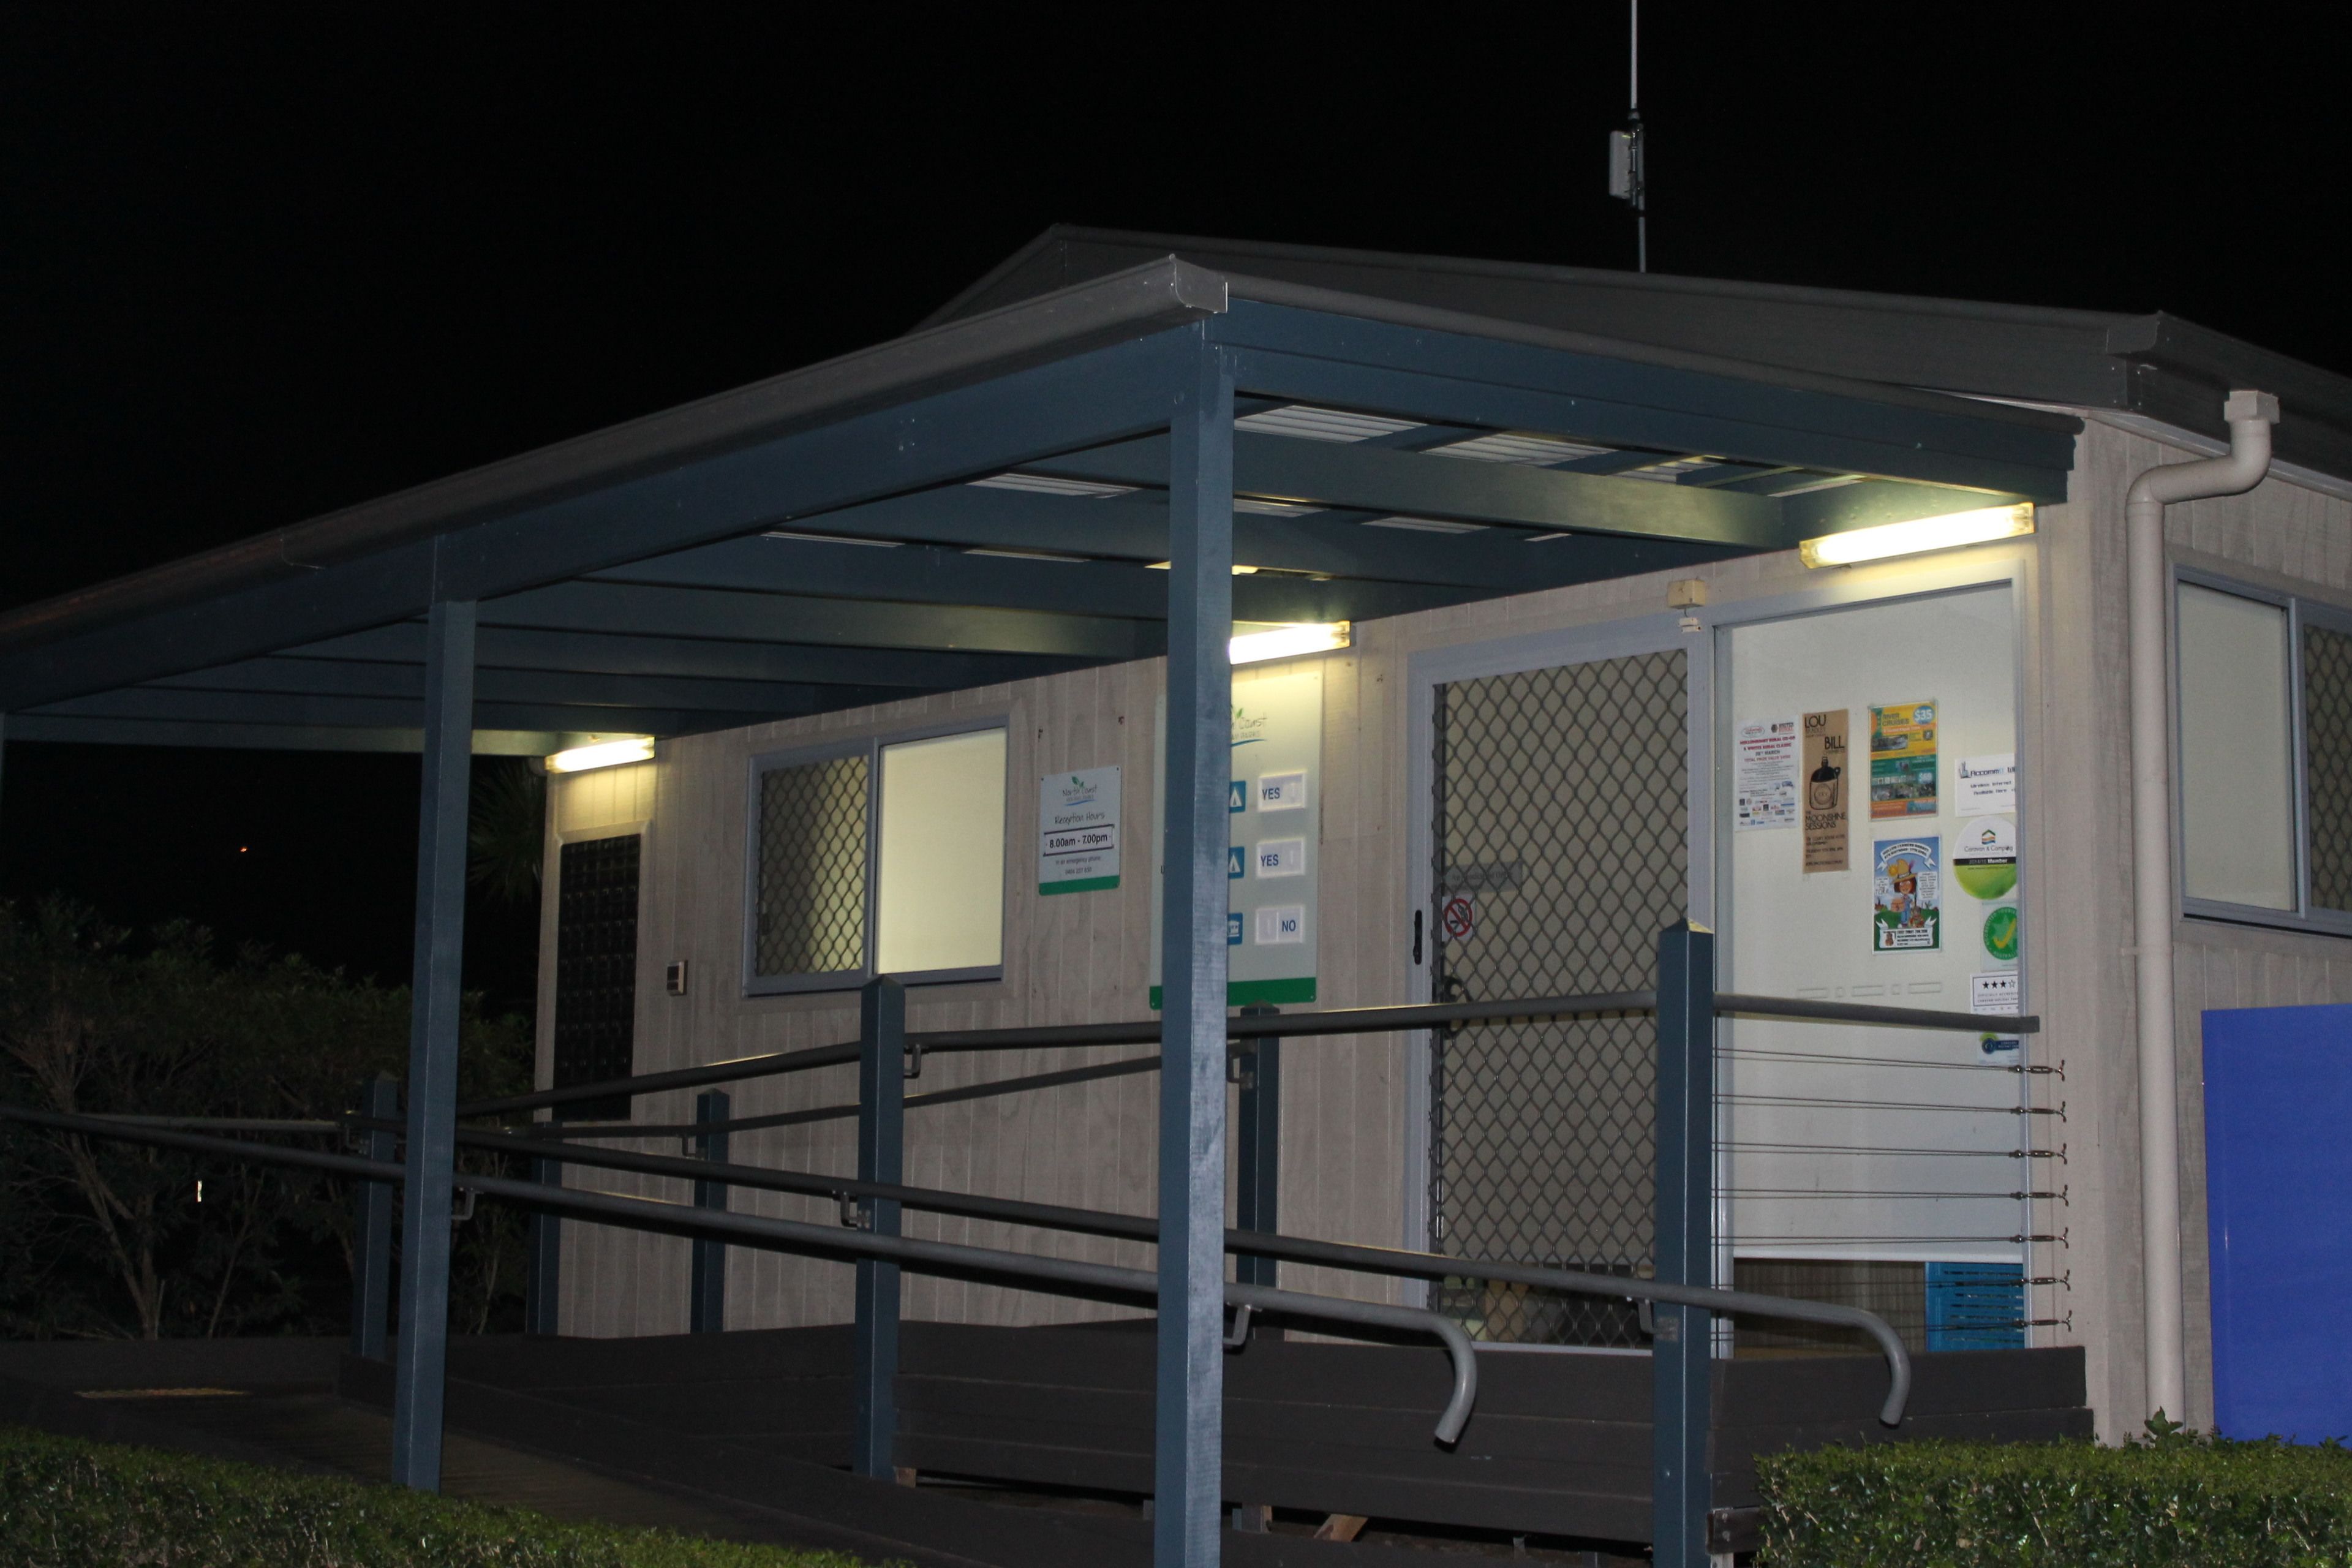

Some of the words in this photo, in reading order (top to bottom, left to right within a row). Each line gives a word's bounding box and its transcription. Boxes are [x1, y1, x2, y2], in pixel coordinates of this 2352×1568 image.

[1804, 714, 1826, 728] LOU
[1914, 709, 1932, 721] $35
[1824, 736, 1845, 750] BILL
[1262, 787, 1281, 801] YES
[1055, 813, 1084, 826] Reception
[1086, 812, 1106, 821] Hours
[1805, 812, 1846, 823] MOONSHINE
[1805, 822, 1836, 831] SESSIONS
[1050, 838, 1076, 848] 8.00am
[1082, 834, 1107, 845] 7.00pm
[1261, 854, 1279, 867] YES
[1281, 919, 1297, 932] NO
